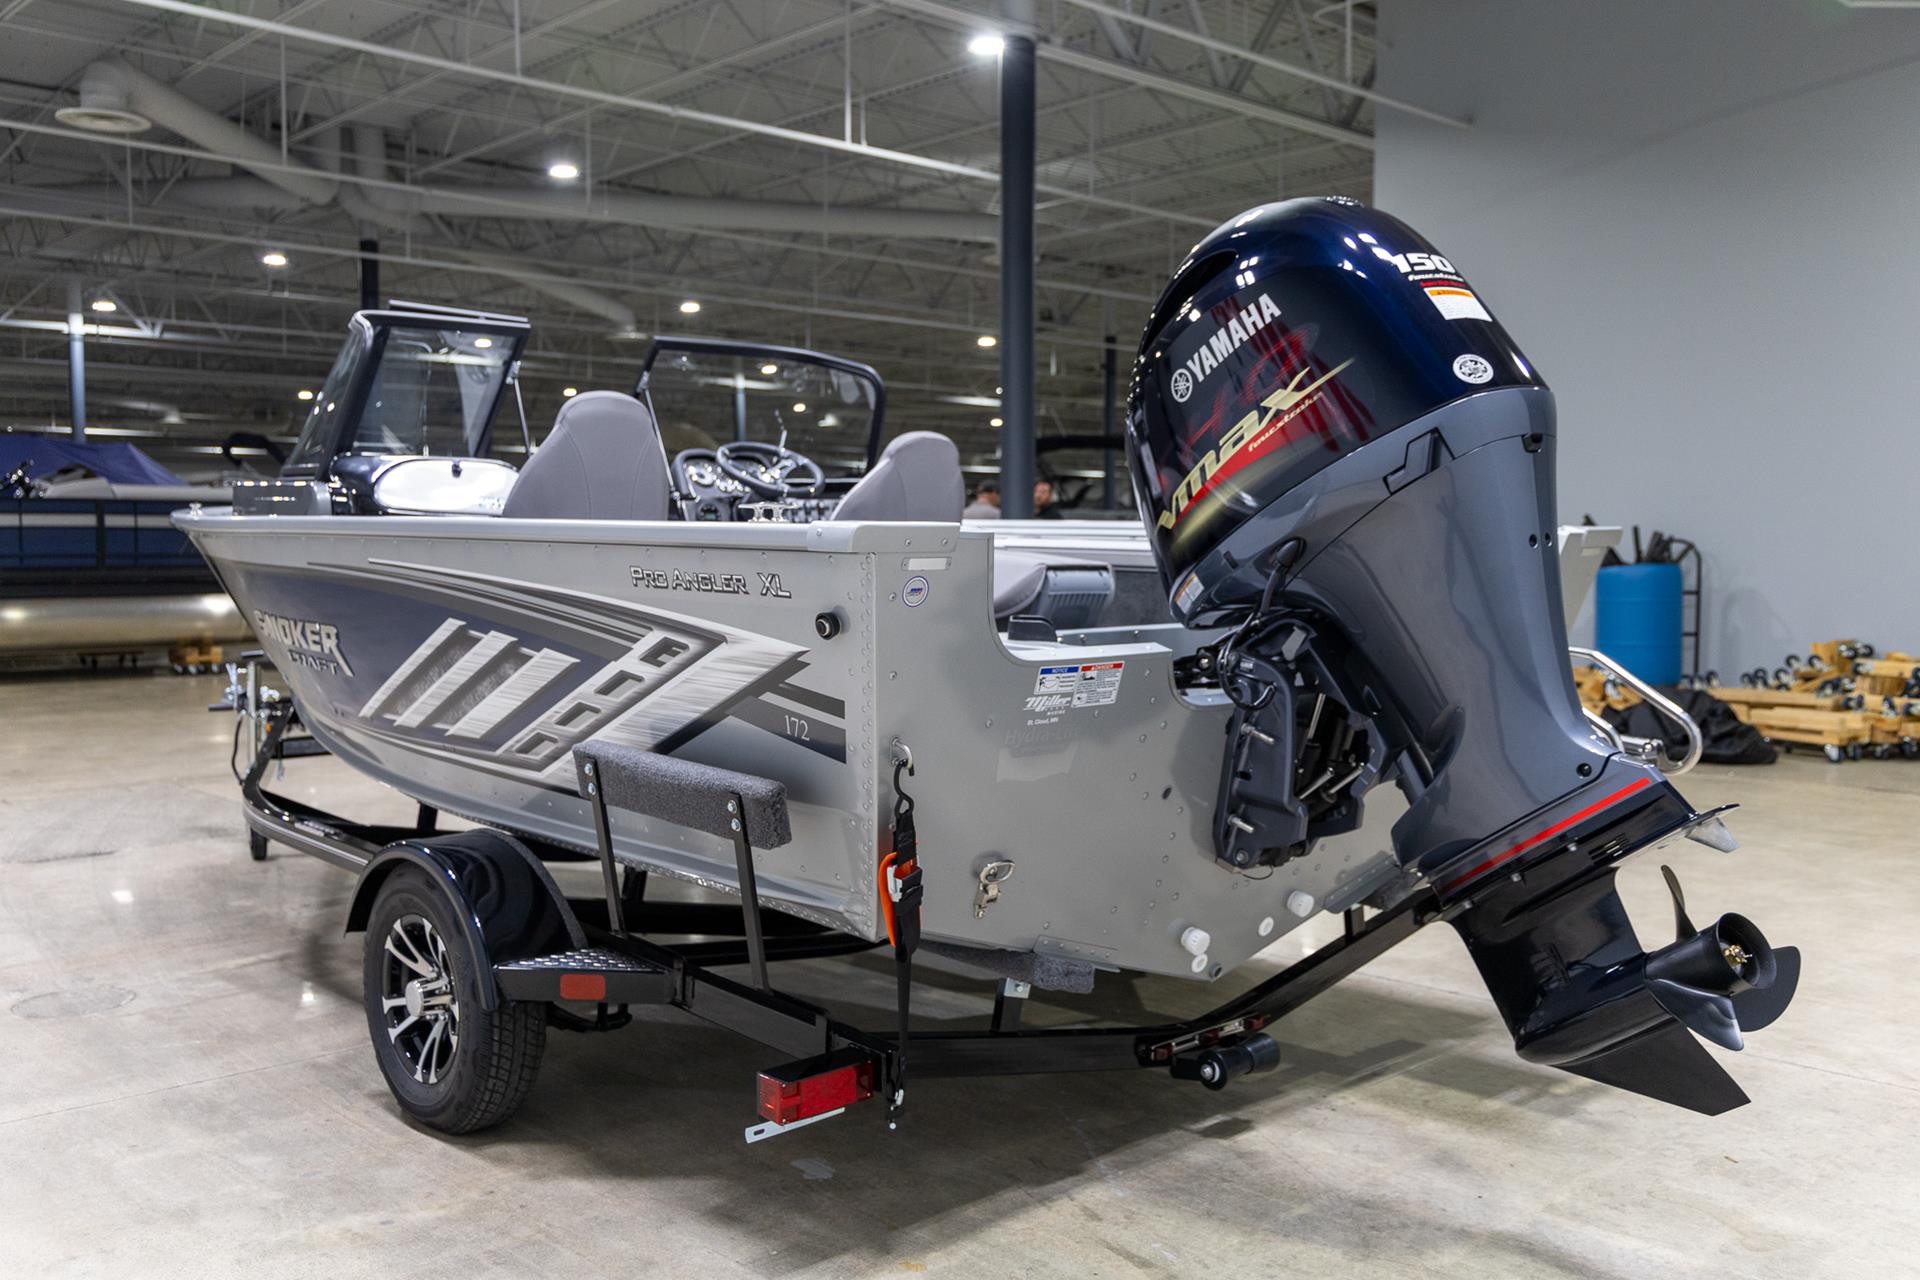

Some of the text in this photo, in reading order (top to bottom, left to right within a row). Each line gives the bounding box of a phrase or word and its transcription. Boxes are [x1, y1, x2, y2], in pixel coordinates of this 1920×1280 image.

[1393, 253, 1456, 273] 150
[1186, 293, 1282, 383] YAMAHA
[757, 572, 792, 599] XL
[254, 608, 355, 678] SMOKER
[1024, 694, 1071, 712] Miller
[784, 714, 810, 741] 172
